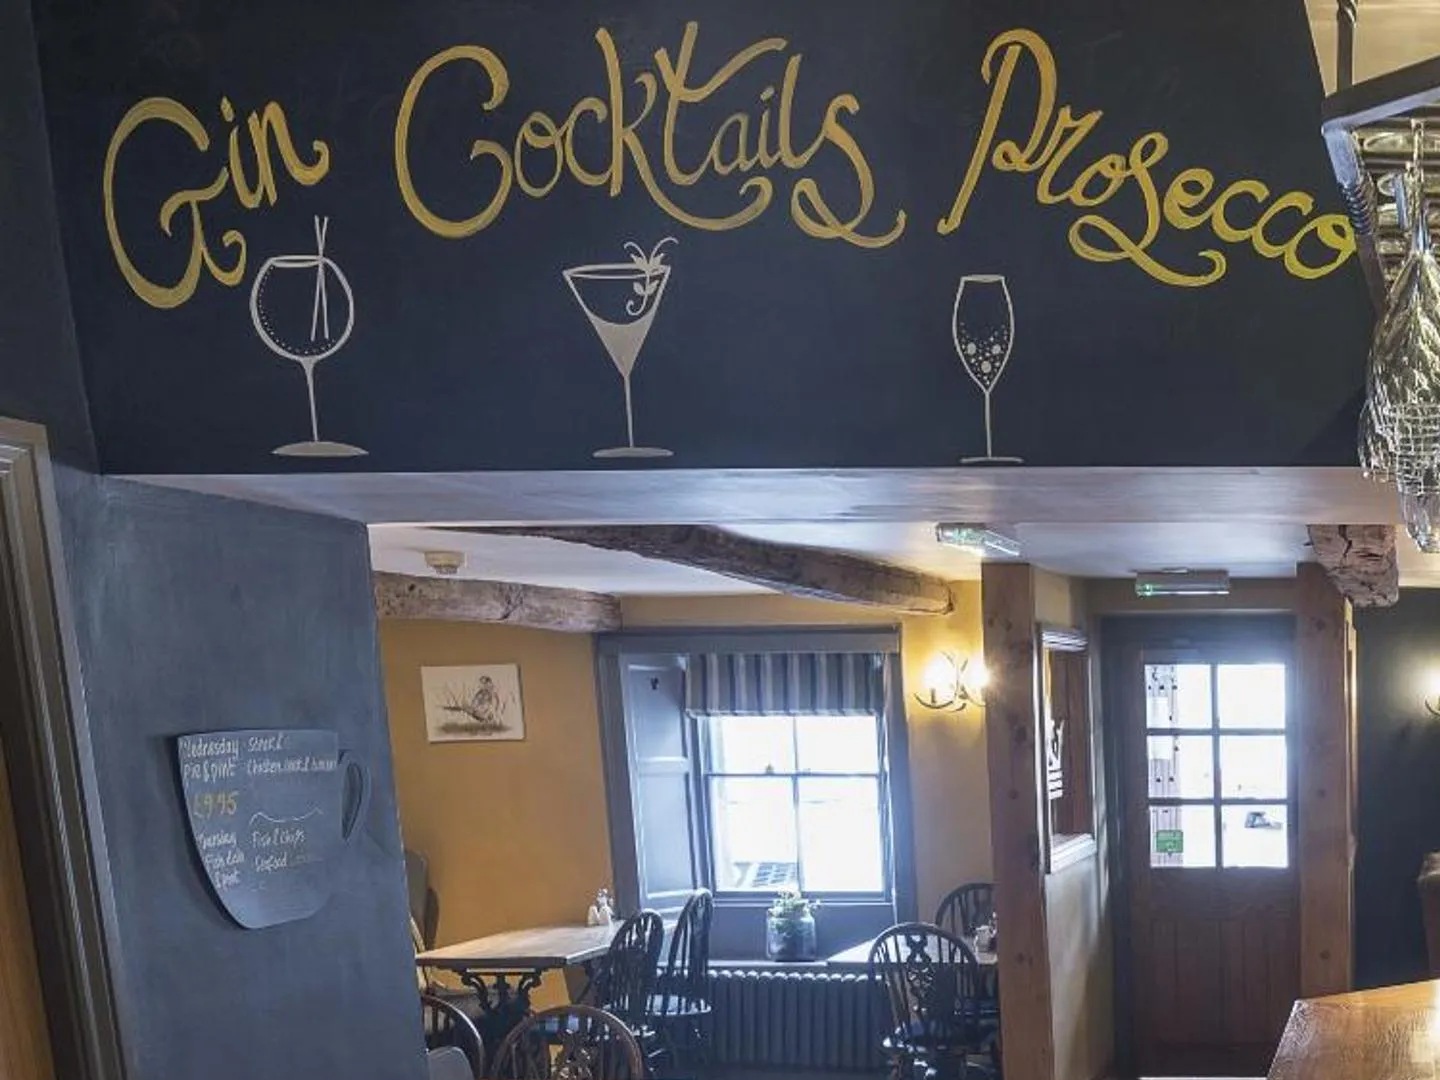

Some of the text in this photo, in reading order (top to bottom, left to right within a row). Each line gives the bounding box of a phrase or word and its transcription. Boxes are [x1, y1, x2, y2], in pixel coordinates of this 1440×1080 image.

[104, 20, 1358, 310] Gin Cocktails Prosecco
